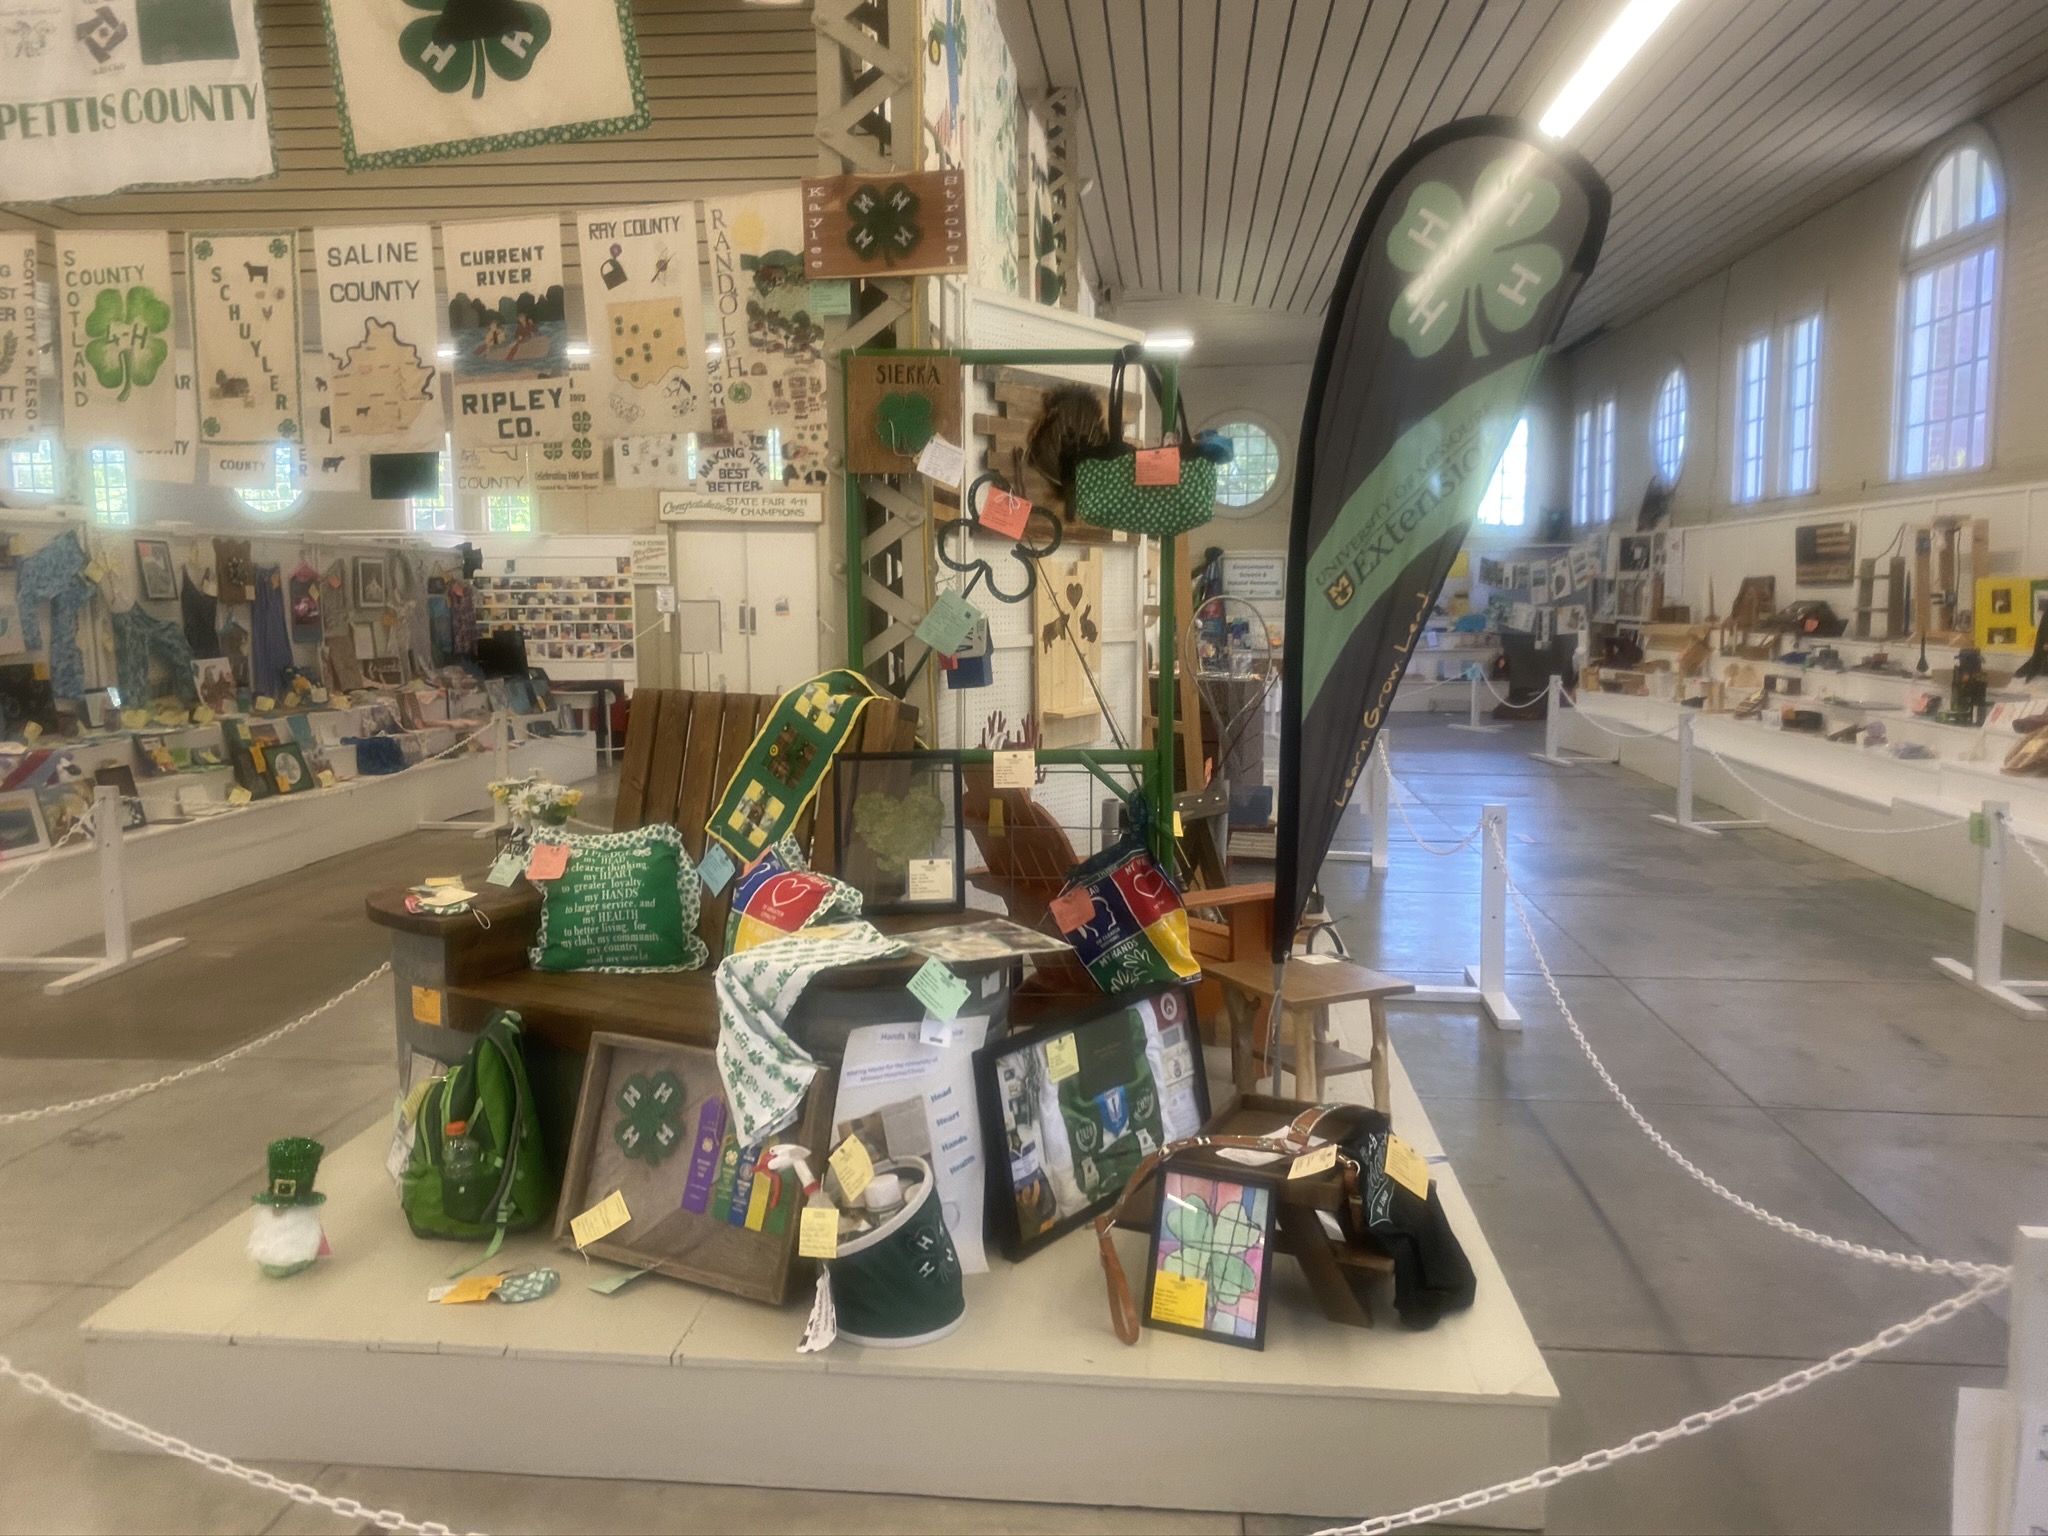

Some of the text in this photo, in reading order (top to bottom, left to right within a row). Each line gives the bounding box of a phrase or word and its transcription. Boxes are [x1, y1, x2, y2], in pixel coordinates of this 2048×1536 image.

[0, 82, 258, 140] PETTIS COUNTY
[588, 216, 681, 241] RAY COUNTY
[807, 186, 825, 270] Kaylee
[944, 175, 961, 266] Strobel
[327, 242, 419, 267] SALINE
[460, 246, 544, 267] CURRENT
[476, 268, 532, 287] RIVER
[1497, 263, 1541, 306] H
[329, 280, 420, 304] COUNTY
[710, 209, 745, 378] RANDOLPH
[24, 248, 37, 420] SCOTT CITY KELSO
[64, 250, 88, 407] SCOTLAND
[106, 322, 148, 349] 4-H
[211, 266, 288, 411] SCHUYLER
[461, 387, 562, 415] RIPLEY
[498, 417, 540, 439] CO.
[699, 448, 768, 478] MAKING THE
[457, 474, 525, 491] COUNTY
[719, 468, 750, 479] BEST
[663, 500, 738, 515] Congratulations
[727, 497, 759, 506] STATE
[762, 497, 785, 506] FAIR
[741, 507, 805, 517] CHAMPIONS
[1352, 440, 1486, 585] Extensio
[1315, 497, 1391, 587] UNIVERSITY
[1396, 474, 1420, 498] OF
[1334, 739, 1371, 808] Learn.
[571, 862, 605, 872] clearer
[601, 856, 626, 865] HEAD
[583, 869, 632, 883] my HEART
[1124, 866, 1135, 876] MY
[561, 885, 570, 893] to
[574, 880, 606, 894] greater
[584, 888, 638, 904] my HANDS
[565, 906, 573, 914] to
[574, 902, 599, 915] larger
[640, 898, 656, 908] and
[582, 909, 638, 926] my HEALTH
[564, 927, 572, 937] to
[574, 925, 600, 936] better
[634, 919, 647, 930] for
[561, 941, 572, 950] my
[597, 936, 610, 946] my
[587, 946, 601, 956] my
[1099, 939, 1139, 968] MY HANDS
[880, 1031, 917, 1041] Hands To
[930, 1086, 953, 1104] Head
[936, 1110, 960, 1127] Heart
[941, 1135, 968, 1152] Hands
[949, 1155, 976, 1175] Health
